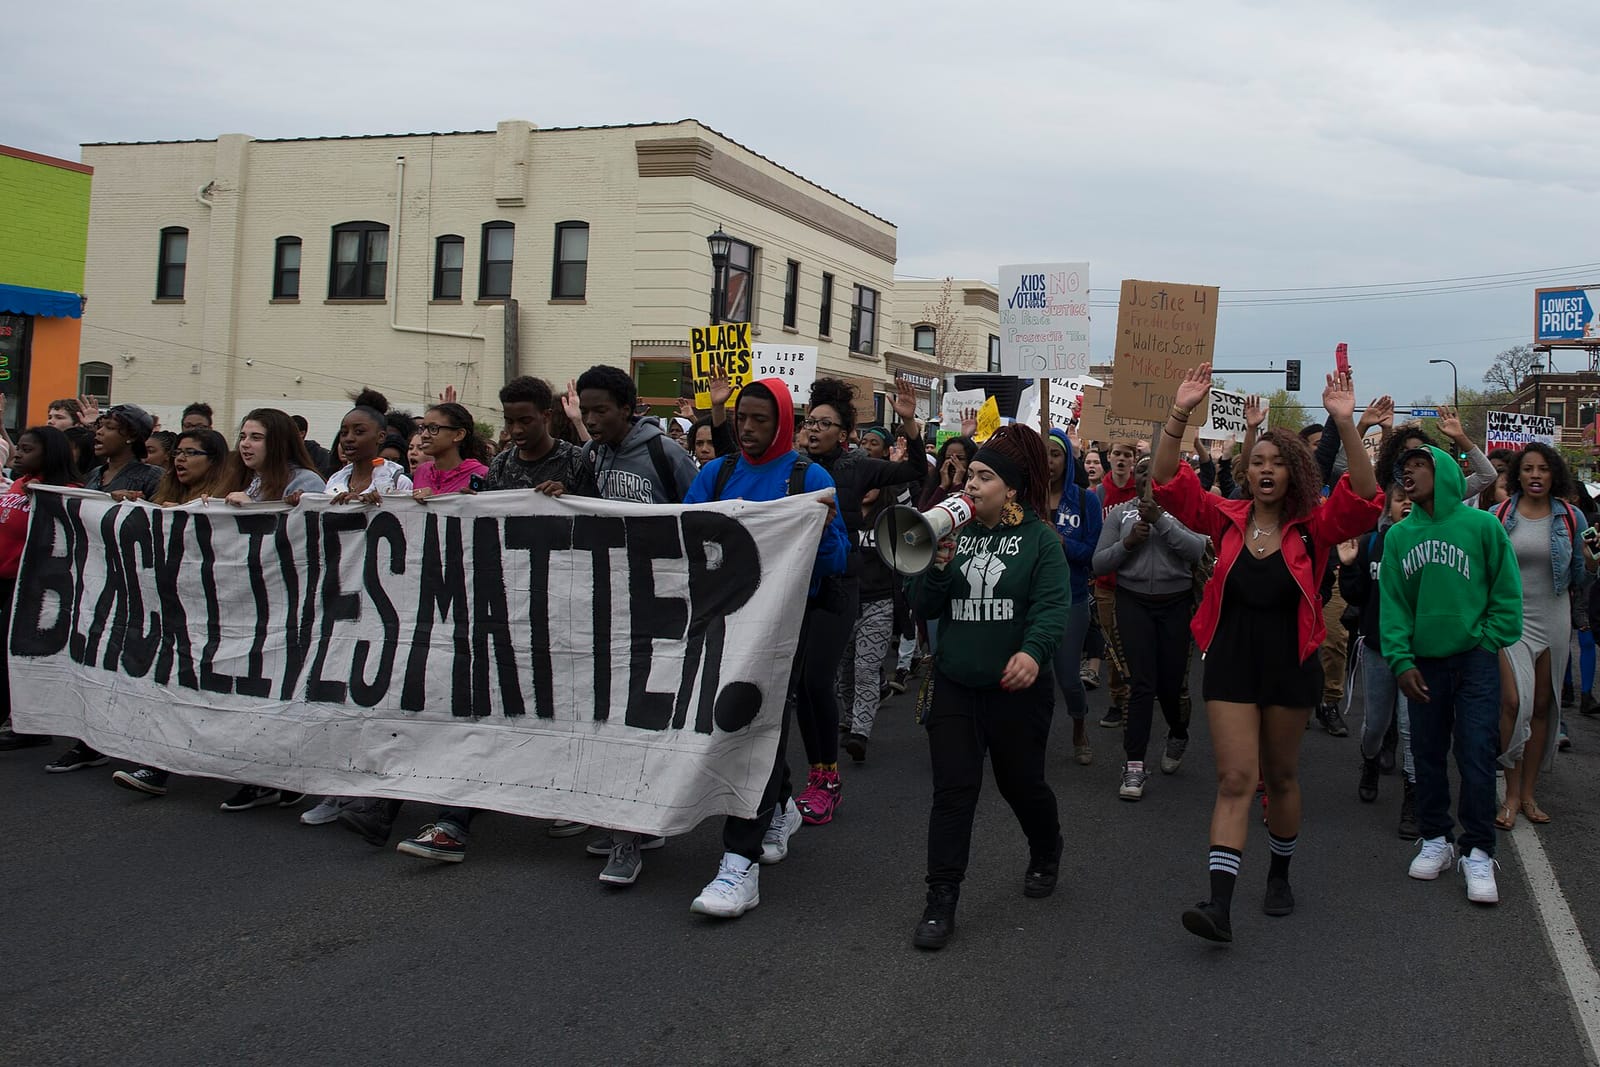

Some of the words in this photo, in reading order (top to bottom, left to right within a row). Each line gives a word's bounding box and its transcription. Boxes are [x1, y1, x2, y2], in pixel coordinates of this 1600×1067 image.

[1021, 274, 1046, 292] KIDS
[1049, 272, 1080, 294] NO
[1129, 285, 1185, 312] Justice
[1194, 289, 1207, 315] 4
[1542, 297, 1584, 313] LOWEST
[1542, 311, 1583, 332] PRICE
[692, 323, 748, 353] BLACK
[1132, 332, 1170, 353] Walter
[1172, 335, 1207, 356] Scott
[696, 350, 751, 378] LIVES
[776, 352, 805, 361] LIFE
[761, 366, 795, 376] DOES
[1130, 355, 1161, 377] Mike
[1163, 358, 1187, 380] Bro
[694, 376, 744, 393] MAER
[1050, 395, 1075, 410] LIVE
[1211, 390, 1247, 407] STOP
[1212, 417, 1265, 437] BRUTATY
[1488, 411, 1517, 424] KNOW
[1487, 430, 1536, 443] DAMAGING
[1489, 423, 1522, 434] WORSE
[1526, 425, 1555, 436] THAN
[956, 535, 993, 556] BLACK
[9, 489, 199, 691] BLACK
[193, 510, 407, 708] LIVES
[951, 599, 1014, 621] MATTER
